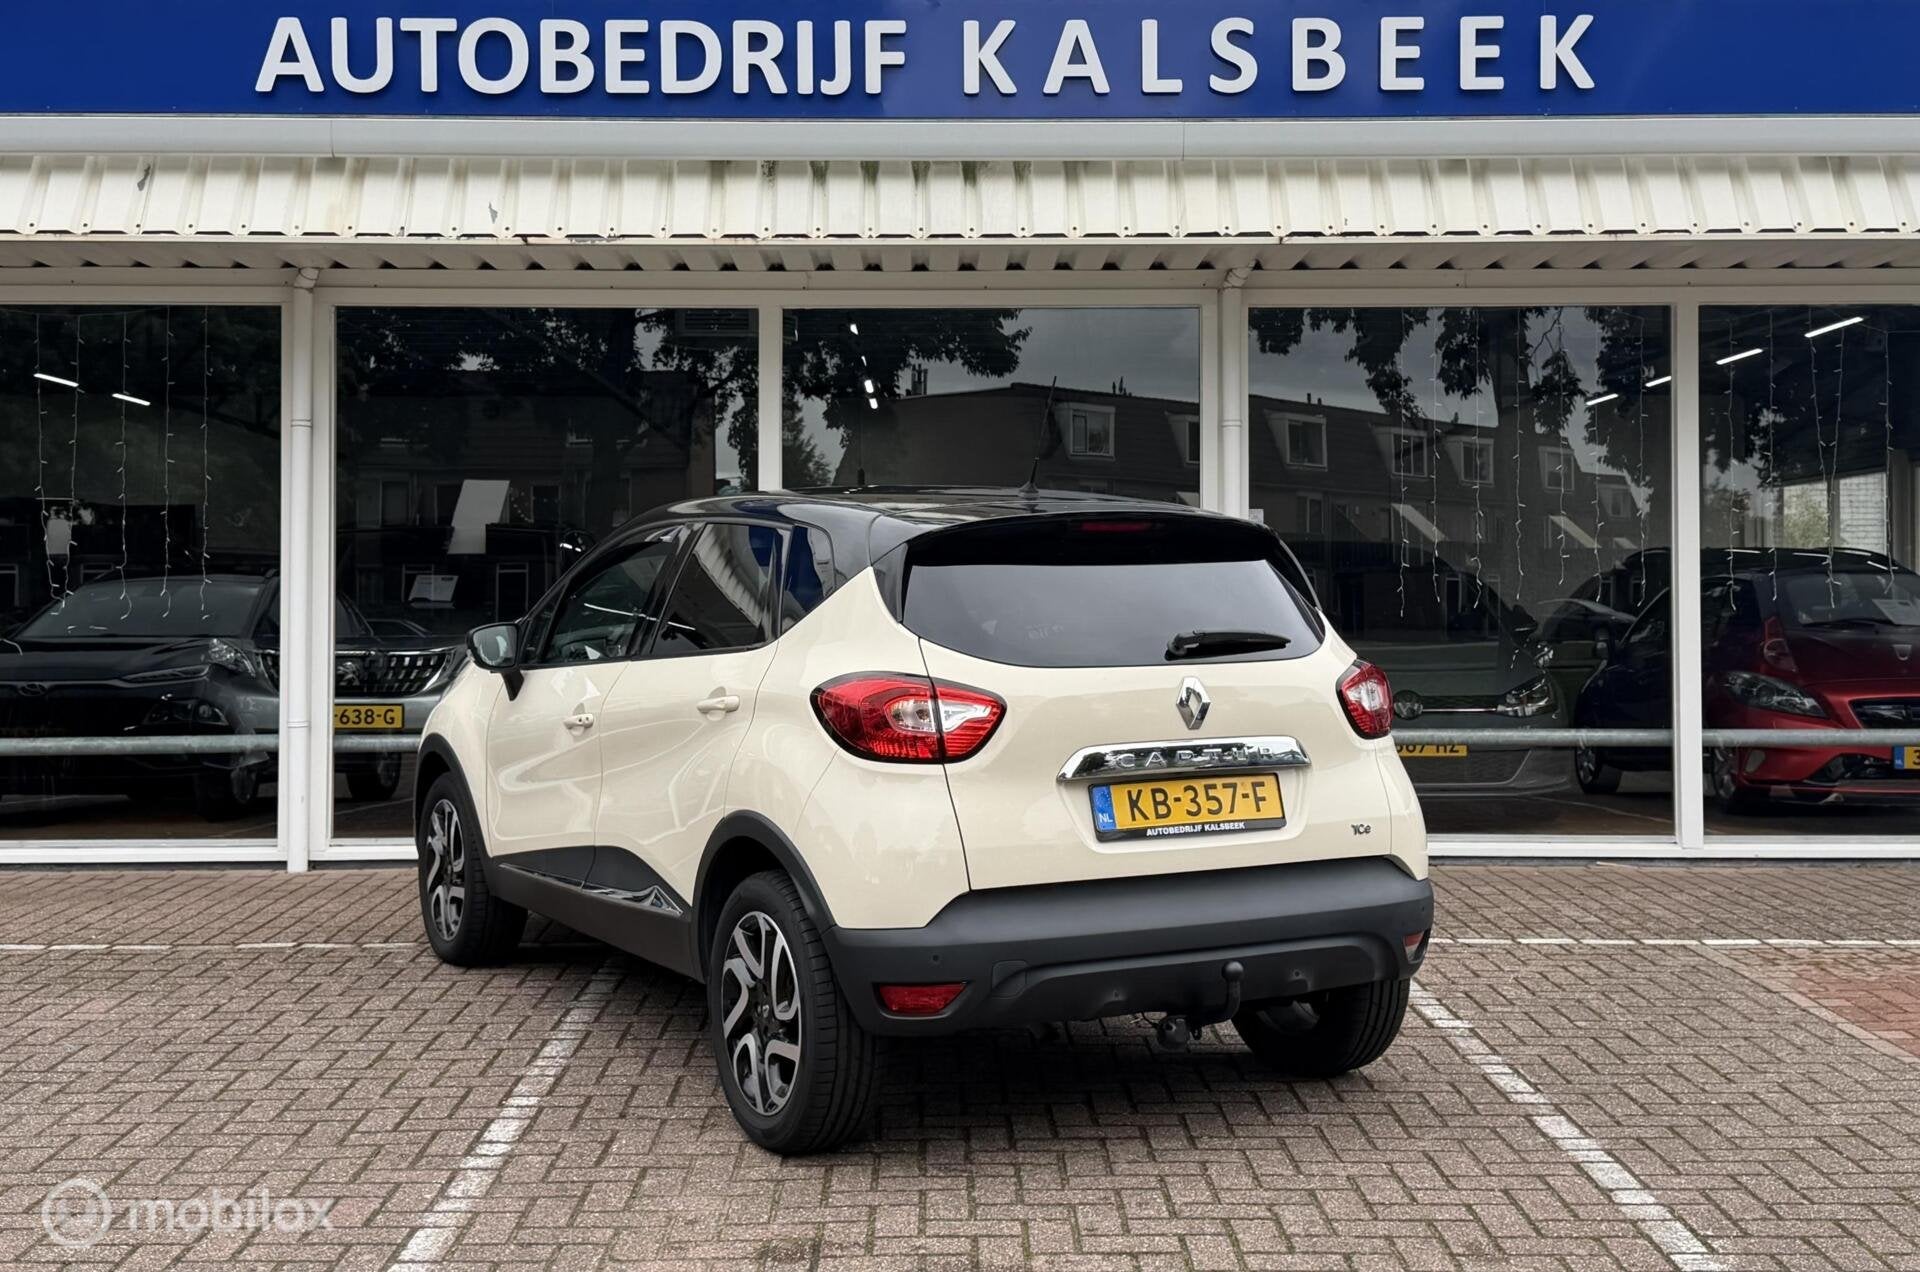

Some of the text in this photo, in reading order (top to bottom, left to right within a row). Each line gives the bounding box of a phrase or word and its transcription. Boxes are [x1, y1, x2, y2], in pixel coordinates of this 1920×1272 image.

[255, 14, 1595, 95] AUTOBEDRIJF KALSBEEK
[1099, 781, 1267, 824] NL KB-357-F
[1146, 821, 1246, 836] AUTOBEDRIJF KALSBEEK
